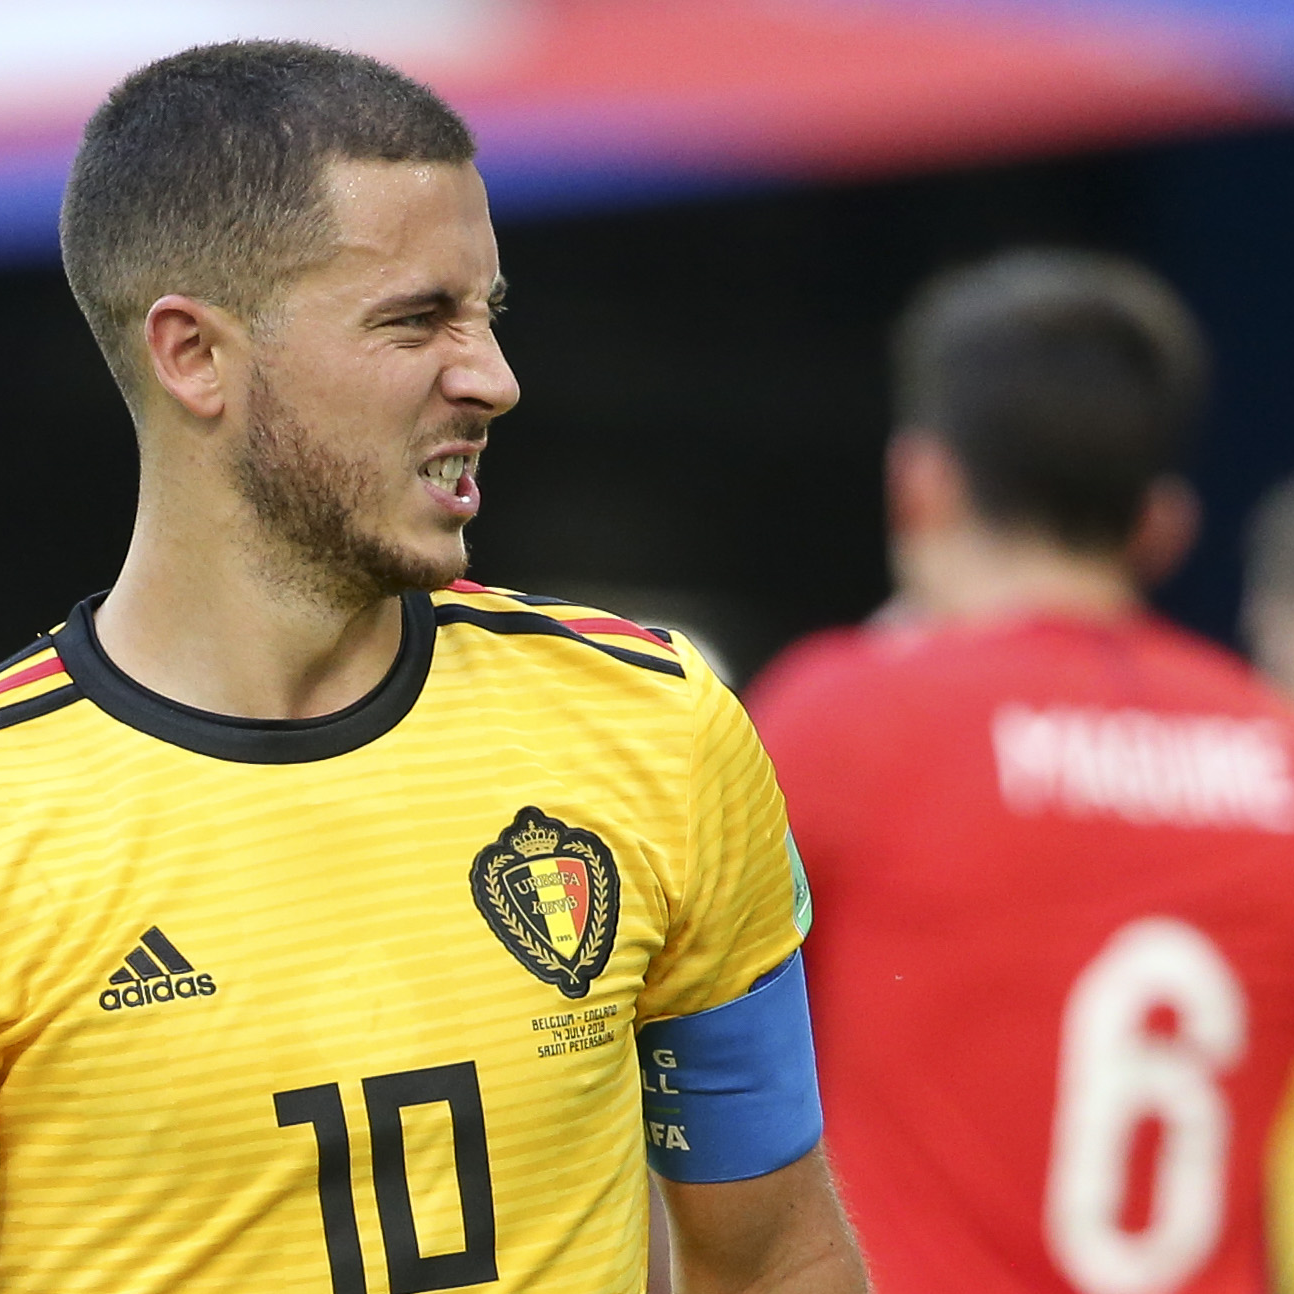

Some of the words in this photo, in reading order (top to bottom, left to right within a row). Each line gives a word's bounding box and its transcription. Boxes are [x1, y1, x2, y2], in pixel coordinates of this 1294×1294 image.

[99, 973, 217, 1011] adidas
[531, 1013, 574, 1031] BELGIUM
[552, 1030, 563, 1041] 14
[565, 1024, 586, 1040] JULY
[588, 1020, 605, 1035] 2018
[537, 1042, 566, 1058] SAINT
[653, 1049, 677, 1068] G
